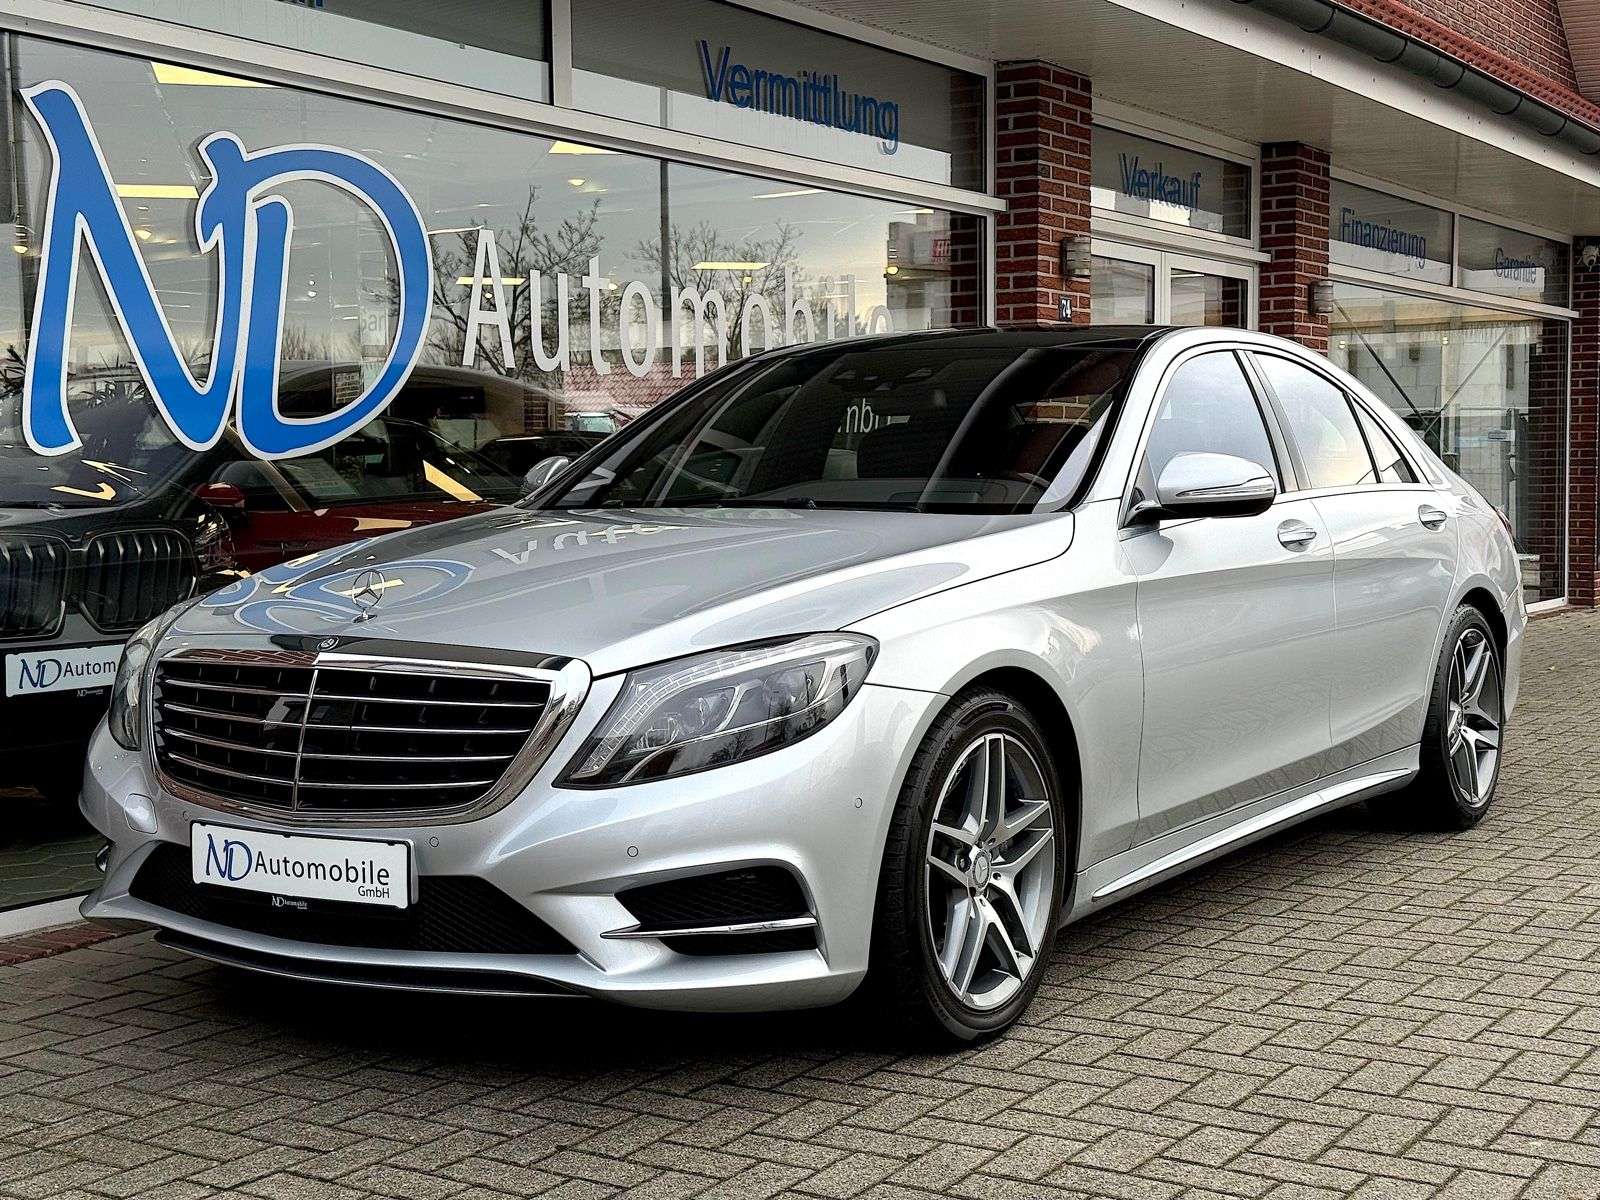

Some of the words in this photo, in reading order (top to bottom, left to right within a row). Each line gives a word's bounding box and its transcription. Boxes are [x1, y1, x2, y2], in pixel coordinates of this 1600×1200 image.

[697, 39, 898, 155] Vermittlung
[1119, 152, 1202, 212] Verkauf
[1341, 207, 1426, 269] Finanzierung
[1495, 247, 1536, 283] Garantie
[19, 80, 434, 460] ND
[18, 657, 62, 689] ND
[63, 659, 116, 677] Autom
[205, 833, 252, 881] ND
[254, 850, 390, 886] Automobile
[357, 885, 390, 899] GmbH
